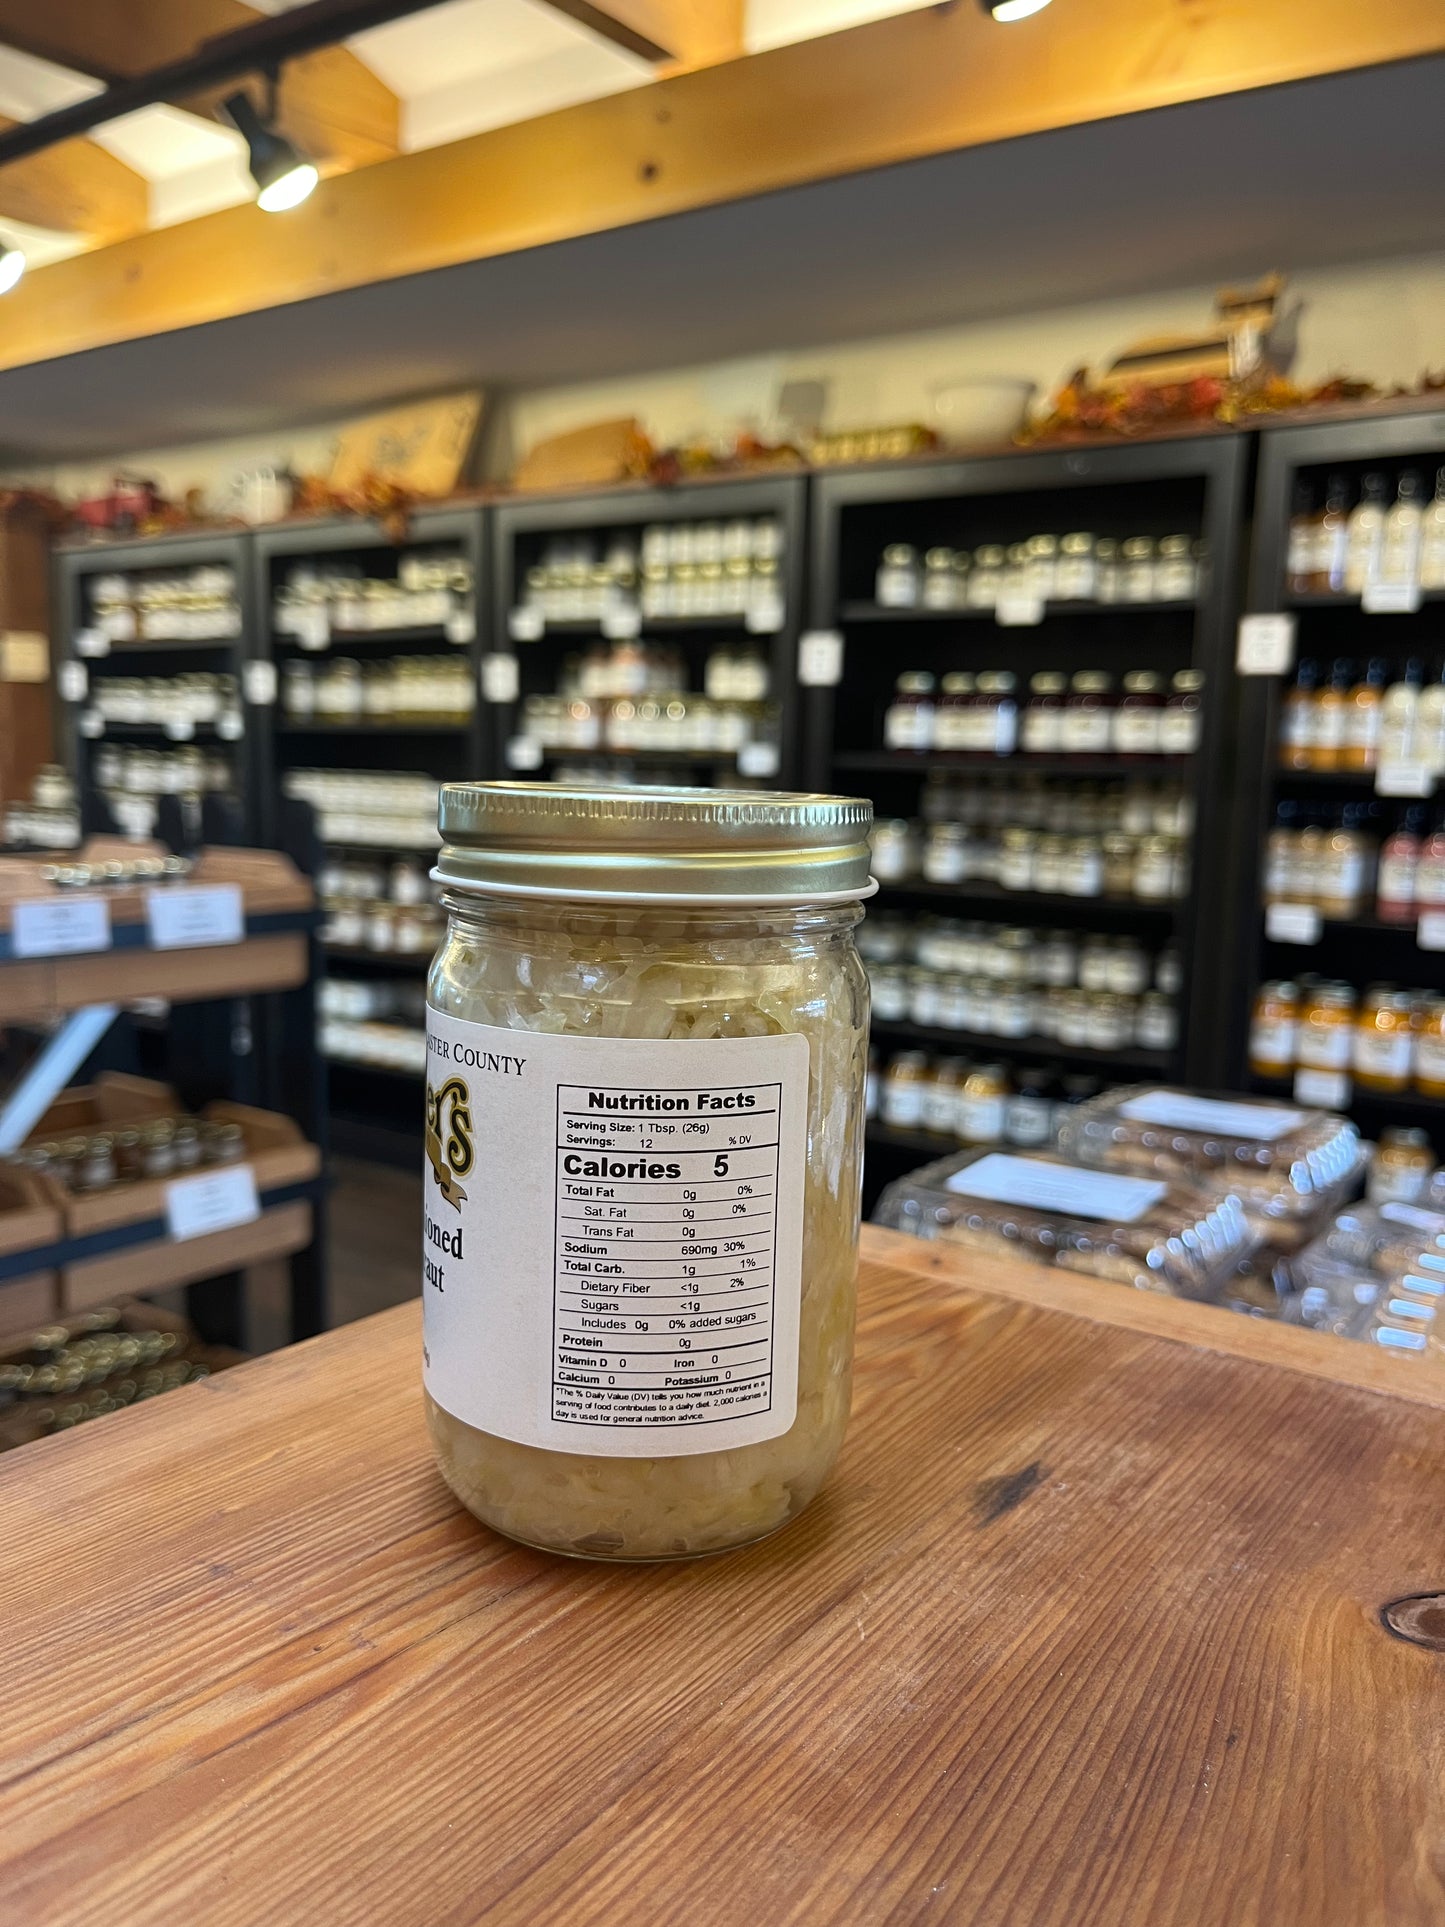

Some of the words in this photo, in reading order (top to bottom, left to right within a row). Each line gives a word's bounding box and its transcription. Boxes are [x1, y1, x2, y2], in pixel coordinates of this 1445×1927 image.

[453, 1043, 527, 1076] COUNTY
[588, 1092, 690, 1110] Nutrition
[697, 1092, 755, 1110] Facts
[566, 1120, 606, 1133] Serving
[609, 1122, 635, 1132] Size:
[638, 1124, 643, 1132] 1
[648, 1123, 678, 1134] Tbsp.
[682, 1123, 710, 1134] (26g)
[566, 1134, 615, 1147] Servings:
[640, 1139, 652, 1148] 12
[729, 1137, 736, 1145] %
[739, 1135, 751, 1144] DV
[564, 1154, 681, 1179] Calories
[714, 1155, 729, 1177] 5
[566, 1185, 592, 1196] Total
[596, 1187, 614, 1197] Fat
[683, 1190, 696, 1200] 0g
[738, 1185, 752, 1195] 0%
[584, 1206, 605, 1216] Sat.
[610, 1208, 627, 1217] Fat
[683, 1209, 694, 1219] 0g
[732, 1204, 746, 1214] 0%
[582, 1225, 613, 1237] Trans
[616, 1228, 634, 1238] Fat
[682, 1228, 695, 1238] 0g
[564, 1242, 607, 1254] Sodium
[682, 1245, 718, 1255] 690mg
[724, 1242, 745, 1251] 30%
[564, 1260, 590, 1272] Total
[595, 1264, 625, 1273] Carb.
[682, 1266, 696, 1276] 1g
[740, 1258, 755, 1268] 1%
[581, 1281, 619, 1294] Dietary
[622, 1283, 650, 1293] Fiber
[681, 1283, 699, 1293] <1g
[730, 1278, 744, 1288] 2%
[581, 1299, 619, 1312] Sugars
[681, 1301, 700, 1311] <1g
[581, 1317, 626, 1329] Includes
[635, 1321, 648, 1331] 0g
[669, 1320, 686, 1329] 0%
[690, 1317, 721, 1328] added
[724, 1312, 756, 1325] sugars
[563, 1334, 602, 1347] Protein
[679, 1339, 691, 1349] 0g
[559, 1354, 596, 1367] Vitamin
[600, 1359, 607, 1367] D
[619, 1359, 626, 1368] 0
[674, 1359, 694, 1368] Iron
[712, 1355, 718, 1364] 0
[558, 1372, 600, 1384] Calcium
[608, 1376, 615, 1385] 0
[665, 1373, 719, 1386] Potassium
[725, 1371, 731, 1380] 0
[586, 1391, 605, 1400] Daily
[631, 1394, 650, 1402] (DV)
[726, 1383, 751, 1394] nutrient
[556, 1400, 582, 1409] serving
[714, 1397, 734, 1407] 2,000
[736, 1393, 761, 1402] calories
[556, 1410, 569, 1418] day
[644, 1414, 676, 1422] nutrition
[678, 1413, 704, 1421] advice.
